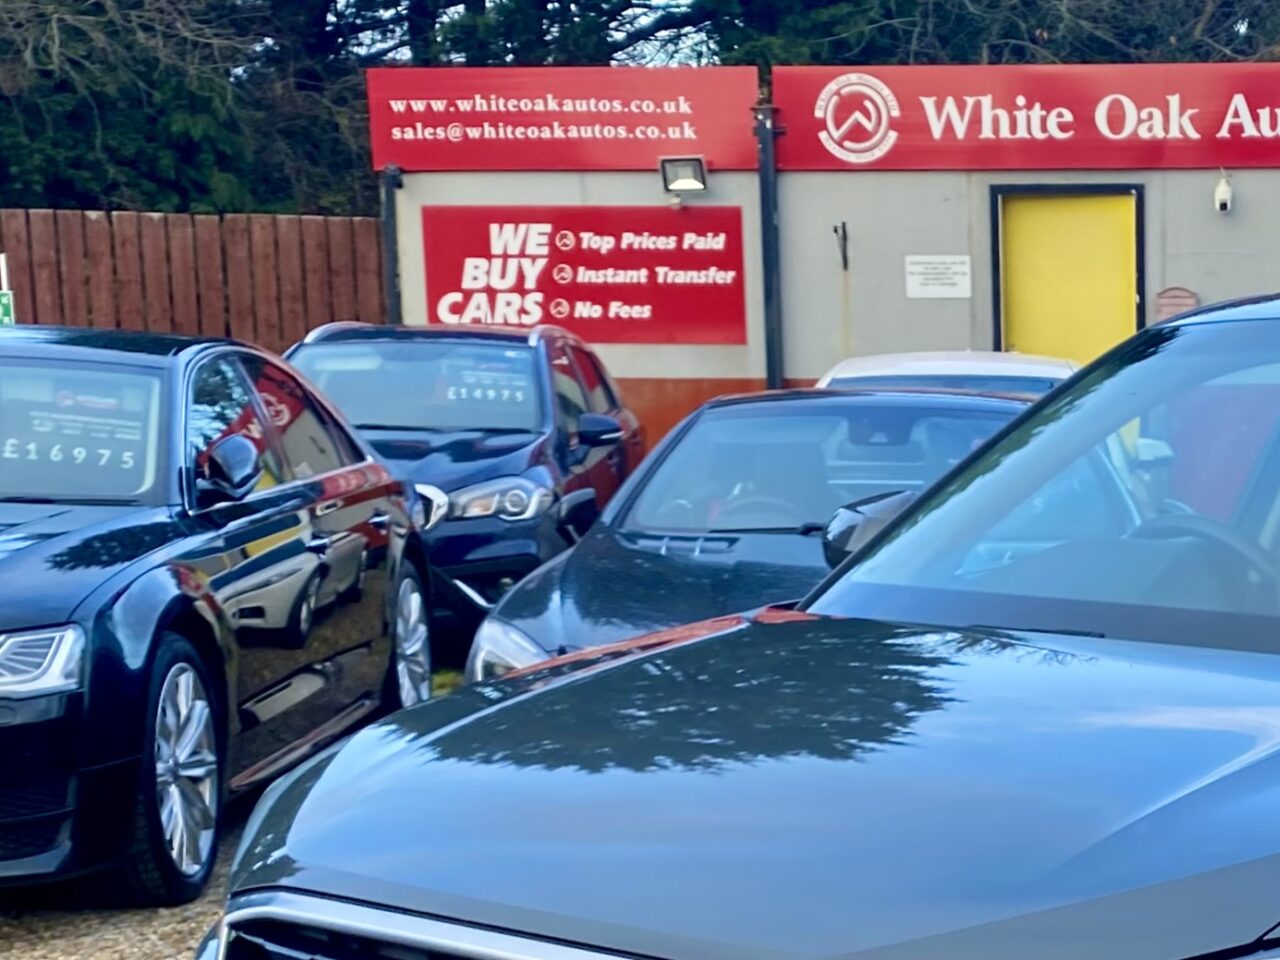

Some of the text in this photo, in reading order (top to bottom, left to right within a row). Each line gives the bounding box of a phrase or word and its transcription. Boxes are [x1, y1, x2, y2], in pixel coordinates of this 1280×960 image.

[389, 94, 692, 115] www.whiteoakautos.co.uk
[920, 94, 1074, 141] White
[1095, 93, 1201, 141] Oak
[391, 121, 697, 142] sales@whiteoakautos.co.uk
[489, 222, 552, 256] WE
[579, 232, 726, 254] Top Prices Paid
[461, 257, 549, 290] BUY
[576, 265, 736, 284] Instant Transfer
[436, 291, 543, 325] CARS
[574, 301, 652, 319] No Fees
[2, 438, 135, 469] £16975
